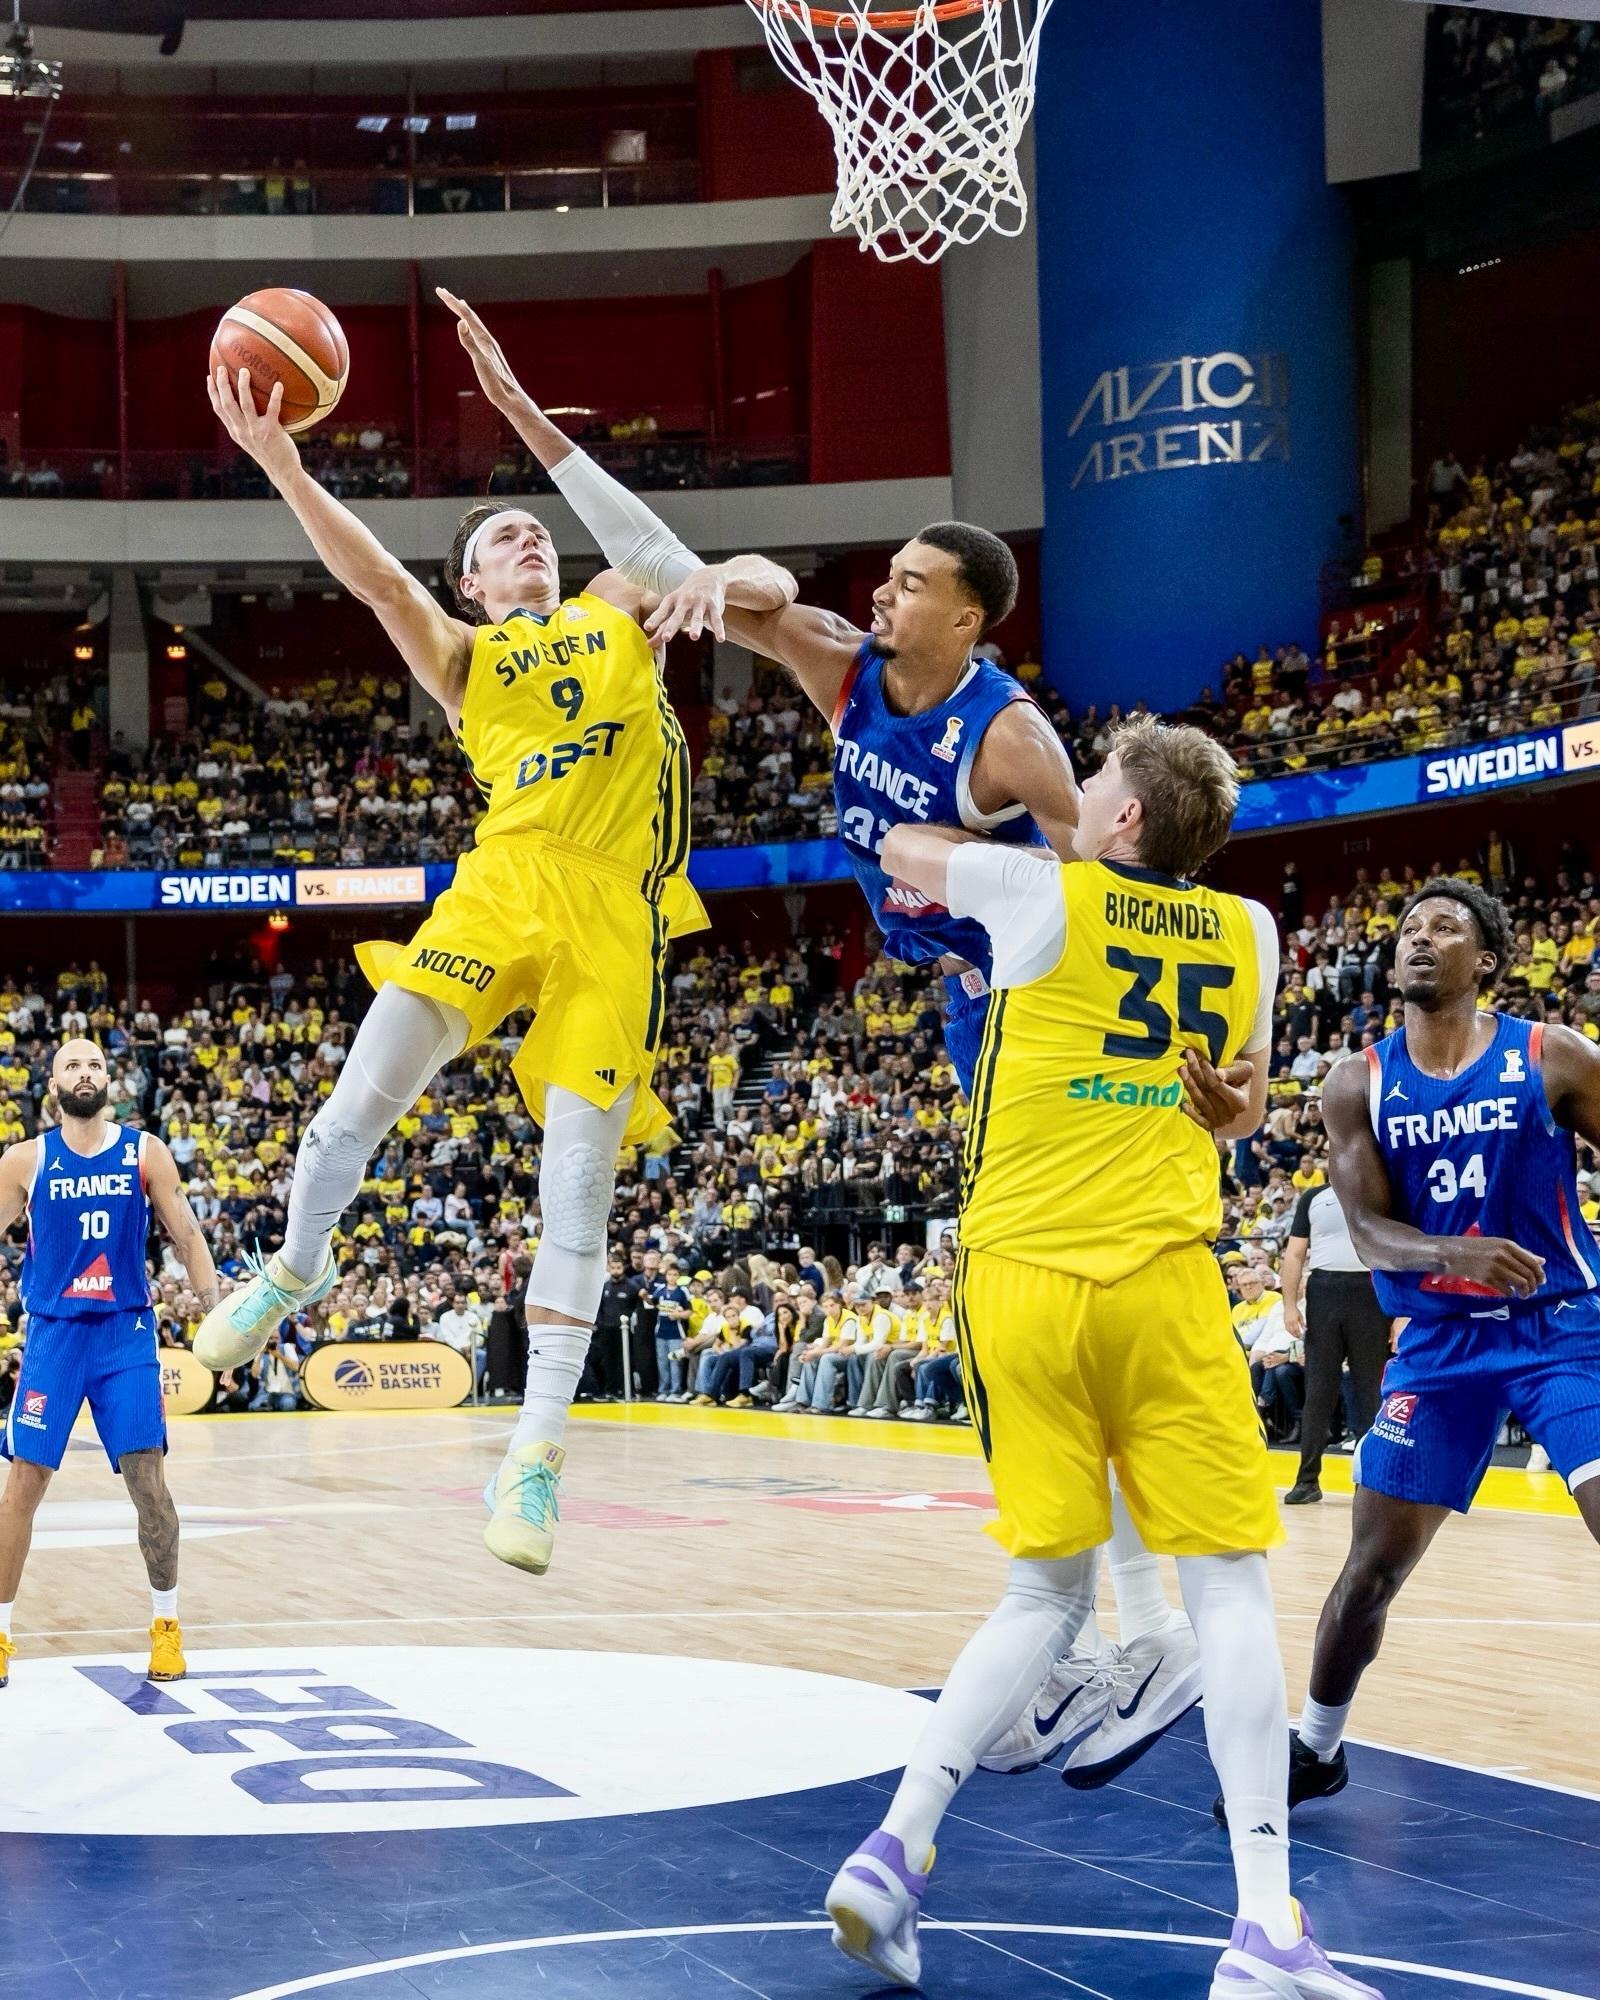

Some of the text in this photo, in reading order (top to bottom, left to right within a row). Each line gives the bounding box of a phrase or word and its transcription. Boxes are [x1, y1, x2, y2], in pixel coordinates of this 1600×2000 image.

[1070, 420, 1290, 490] ARENA
[495, 631, 607, 687] SWEDEN
[550, 676, 585, 722] 9
[515, 721, 626, 790] DBET
[1426, 736, 1557, 793] SWEDEN
[837, 738, 938, 820] RANCE
[161, 875, 290, 904] SWEDEN
[335, 876, 418, 896] FRANCE
[885, 887, 932, 908] MAI
[1105, 891, 1225, 940] BIRGANDER
[411, 948, 496, 992] NOCCO
[1102, 945, 1236, 1069] 35
[1067, 1074, 1181, 1108] skand
[1387, 1097, 1518, 1149] FRANCE
[49, 1174, 132, 1200] FRANCE
[1427, 1154, 1487, 1203] 34
[78, 1210, 110, 1240] 10
[72, 1276, 113, 1293] MAIF
[379, 1362, 441, 1376] SVENSK
[380, 1376, 441, 1390] BASKET
[1379, 1420, 1407, 1437] CAISSE
